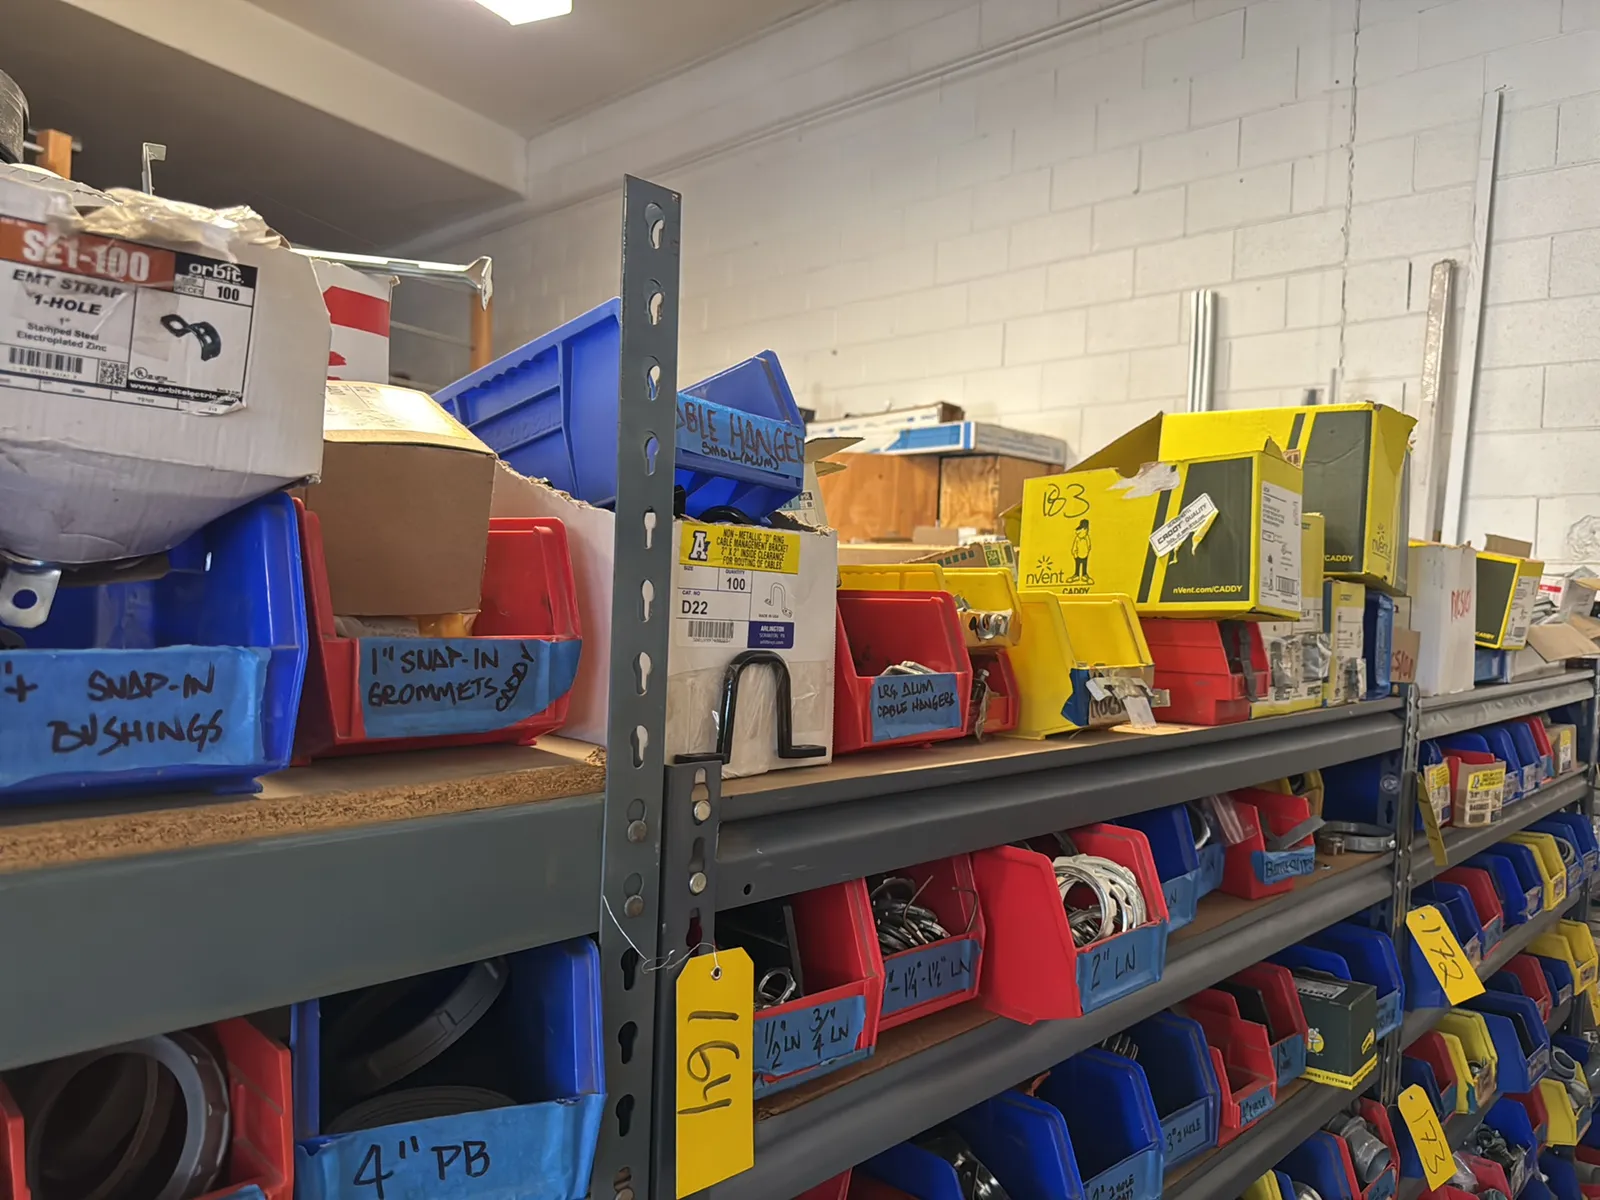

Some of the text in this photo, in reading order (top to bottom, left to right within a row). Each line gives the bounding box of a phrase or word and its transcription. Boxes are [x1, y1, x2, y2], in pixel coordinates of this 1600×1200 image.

[12, 268, 123, 298] EMT STRAP
[217, 286, 240, 301] 100
[33, 293, 102, 316] 1-HOLE
[17, 331, 107, 352] Electroplated Zinc
[28, 322, 99, 341] Stamped Steel
[1043, 483, 1090, 518] 183
[1184, 503, 1207, 523] QUALITY
[717, 537, 732, 547] CABLE
[734, 539, 767, 550] MANAGEMENT
[741, 549, 756, 559] INSIDE
[723, 556, 733, 565] FOR
[757, 559, 763, 568] OF
[765, 560, 782, 569] CABLES
[726, 577, 746, 590] 100
[1026, 569, 1065, 584] nVent
[1173, 585, 1243, 594] nVent.com/CADDY
[681, 600, 708, 615] D22
[371, 645, 499, 675] 1" SNAP-IN
[87, 661, 215, 701] SNAP-IN
[368, 676, 499, 707] GROMMETS
[901, 679, 934, 697] ALUM
[877, 691, 955, 718] CABLE HANGERS
[47, 709, 224, 756] BUSHINGS
[951, 957, 971, 978] LN
[1090, 943, 1136, 991] 2" LN
[1421, 925, 1465, 989] 172
[784, 1027, 800, 1052] LN
[830, 1014, 849, 1043] LN
[1412, 1109, 1446, 1175] 173
[352, 1134, 491, 1200] 4" PB
